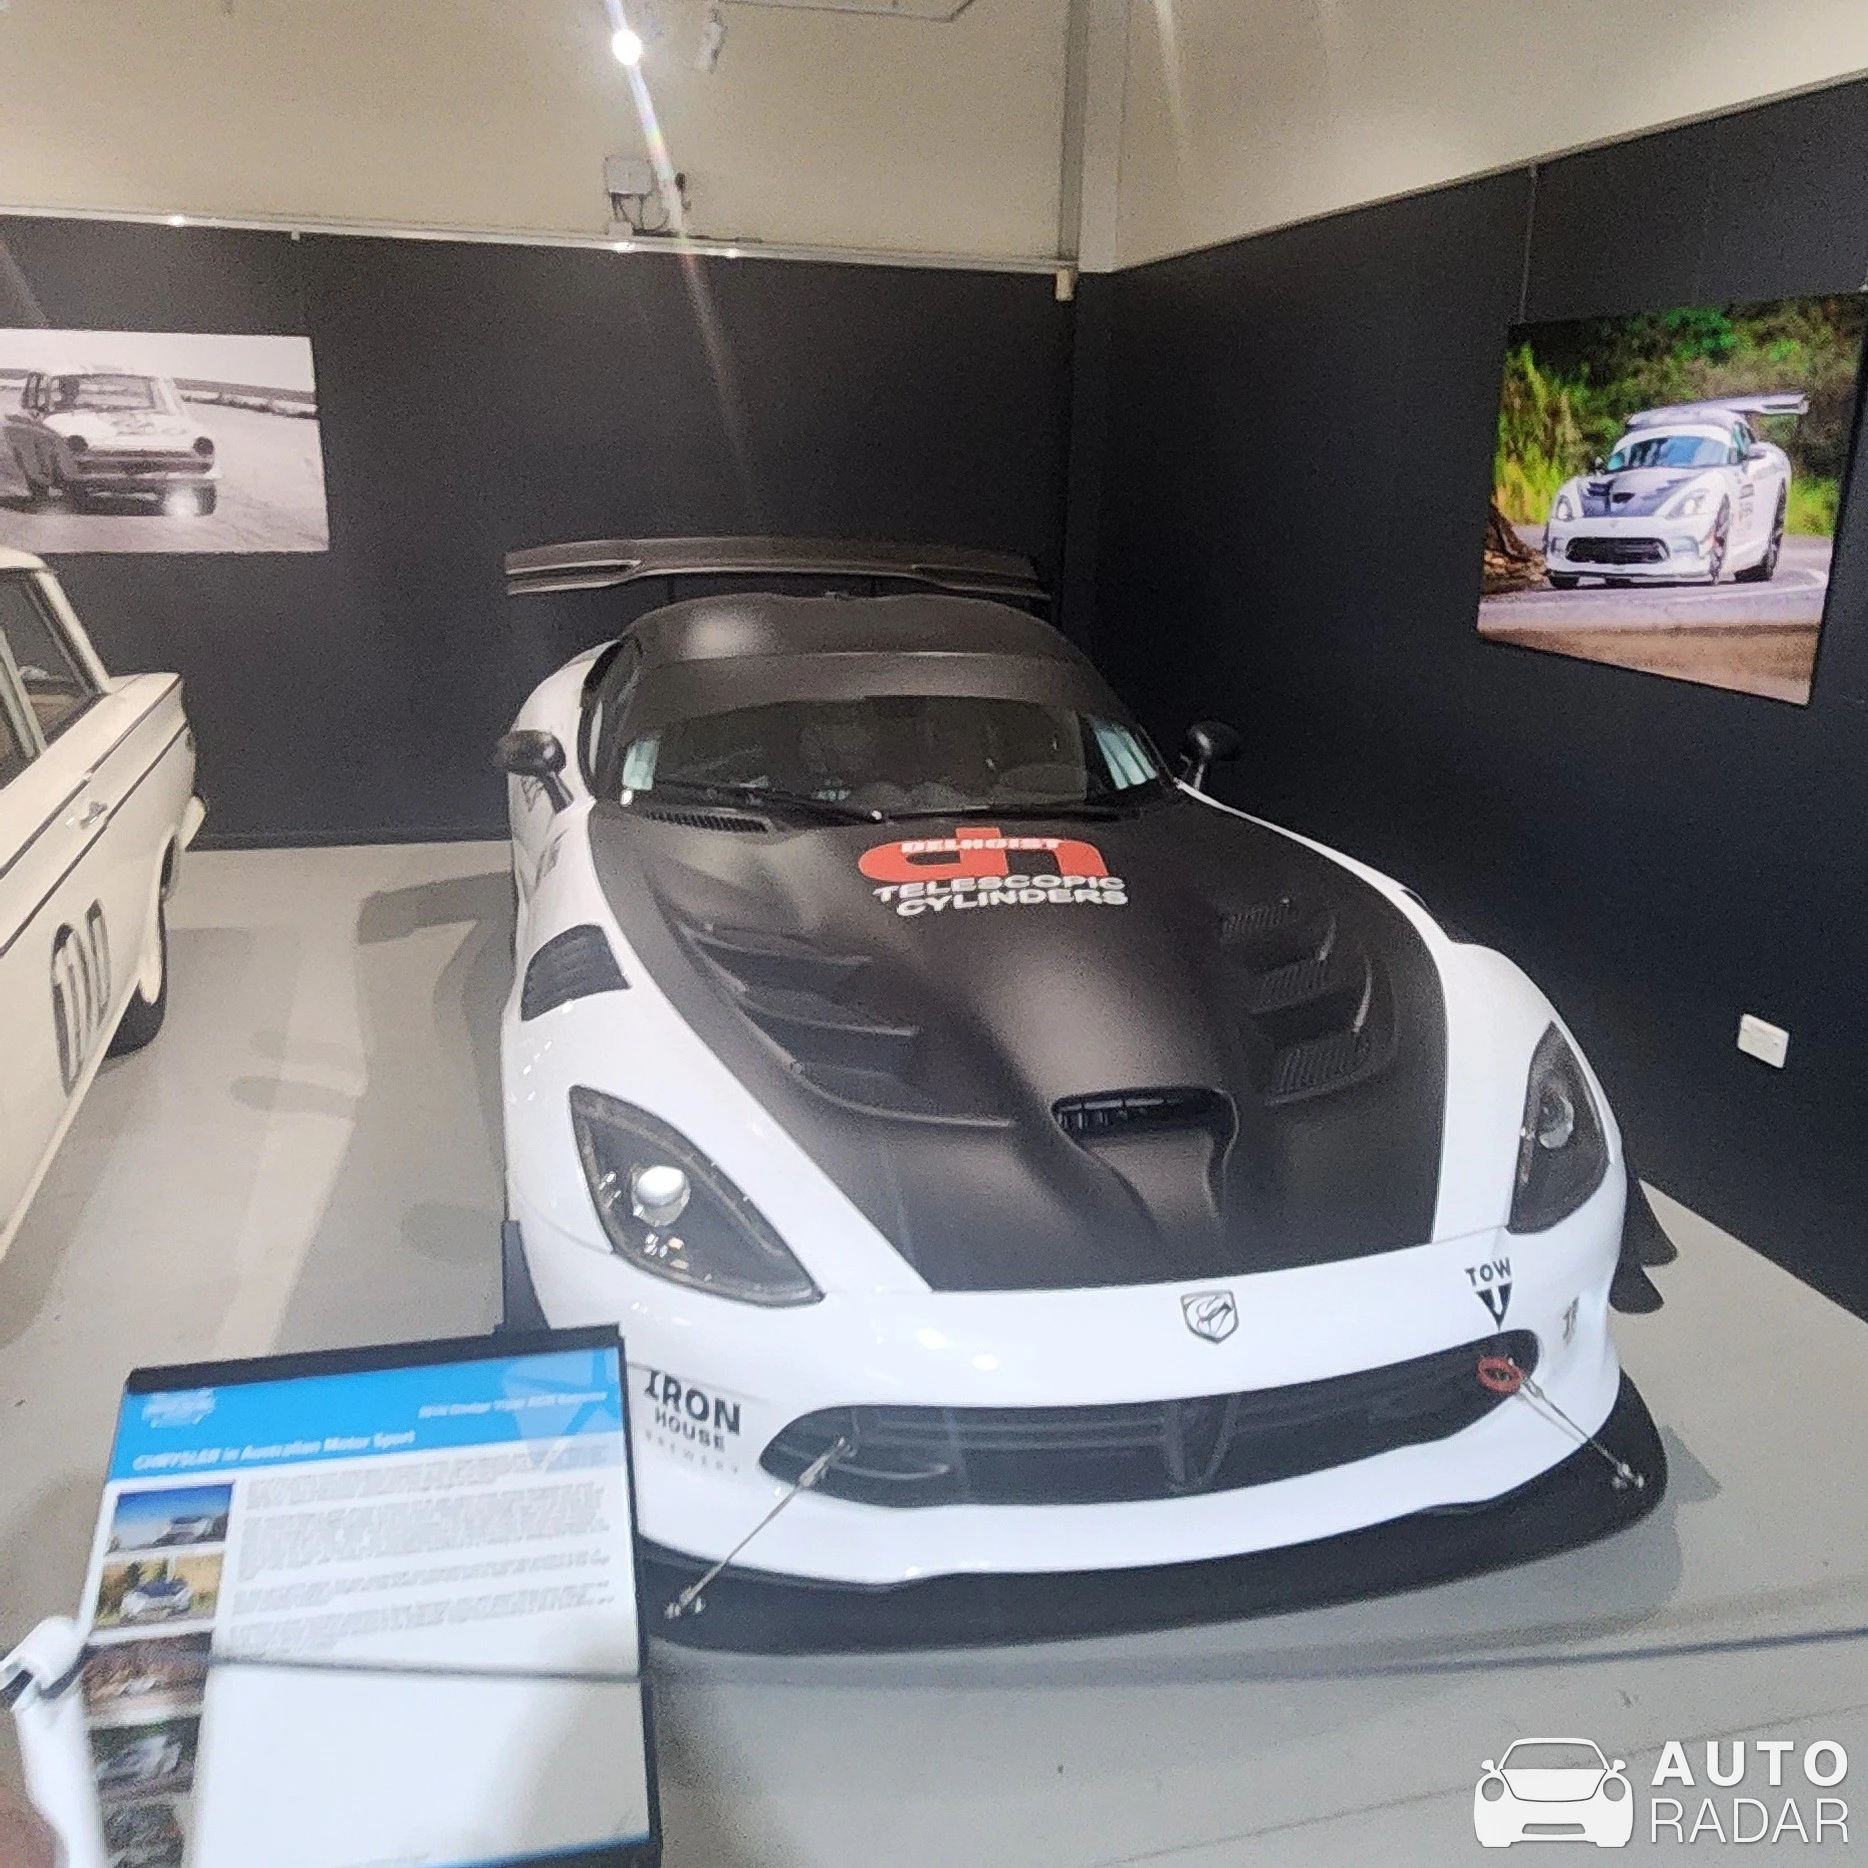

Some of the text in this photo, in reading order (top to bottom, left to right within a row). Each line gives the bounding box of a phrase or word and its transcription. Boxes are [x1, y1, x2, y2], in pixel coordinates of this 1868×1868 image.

[873, 874, 1125, 903] TELESCOPIC
[896, 888, 1129, 917] CYLINDERS
[1464, 1256, 1512, 1286] TOW
[644, 1369, 742, 1436] IRON
[654, 1406, 725, 1452] HOUSE
